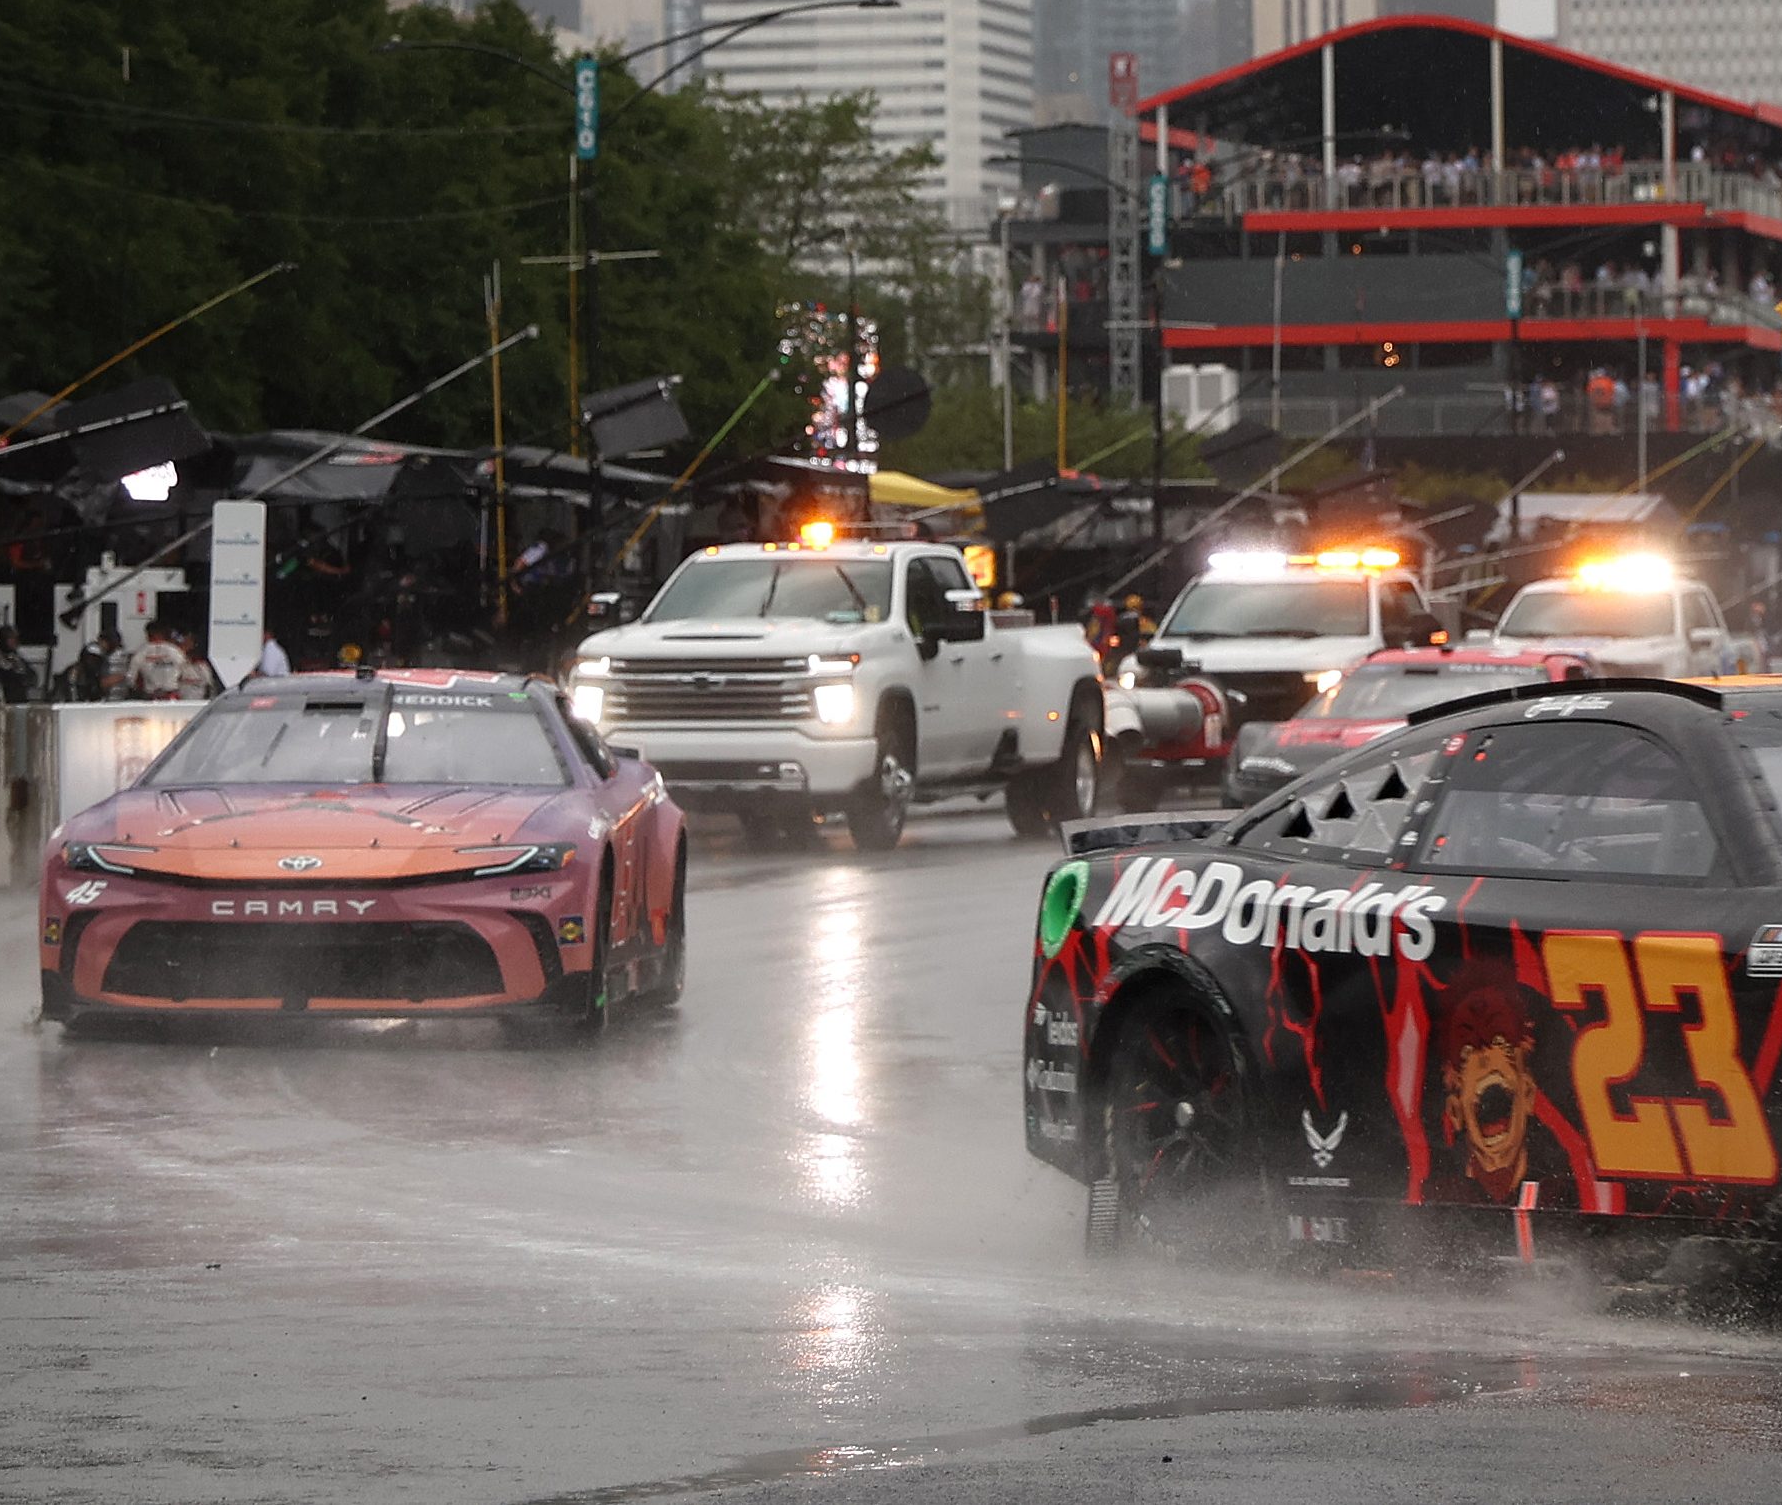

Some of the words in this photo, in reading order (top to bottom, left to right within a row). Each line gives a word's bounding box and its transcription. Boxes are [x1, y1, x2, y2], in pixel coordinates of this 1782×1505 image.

[65, 880, 108, 905] 45
[212, 899, 377, 916] CAMRY
[1093, 856, 1447, 961] McDonald's
[1539, 930, 1780, 1186] 23
